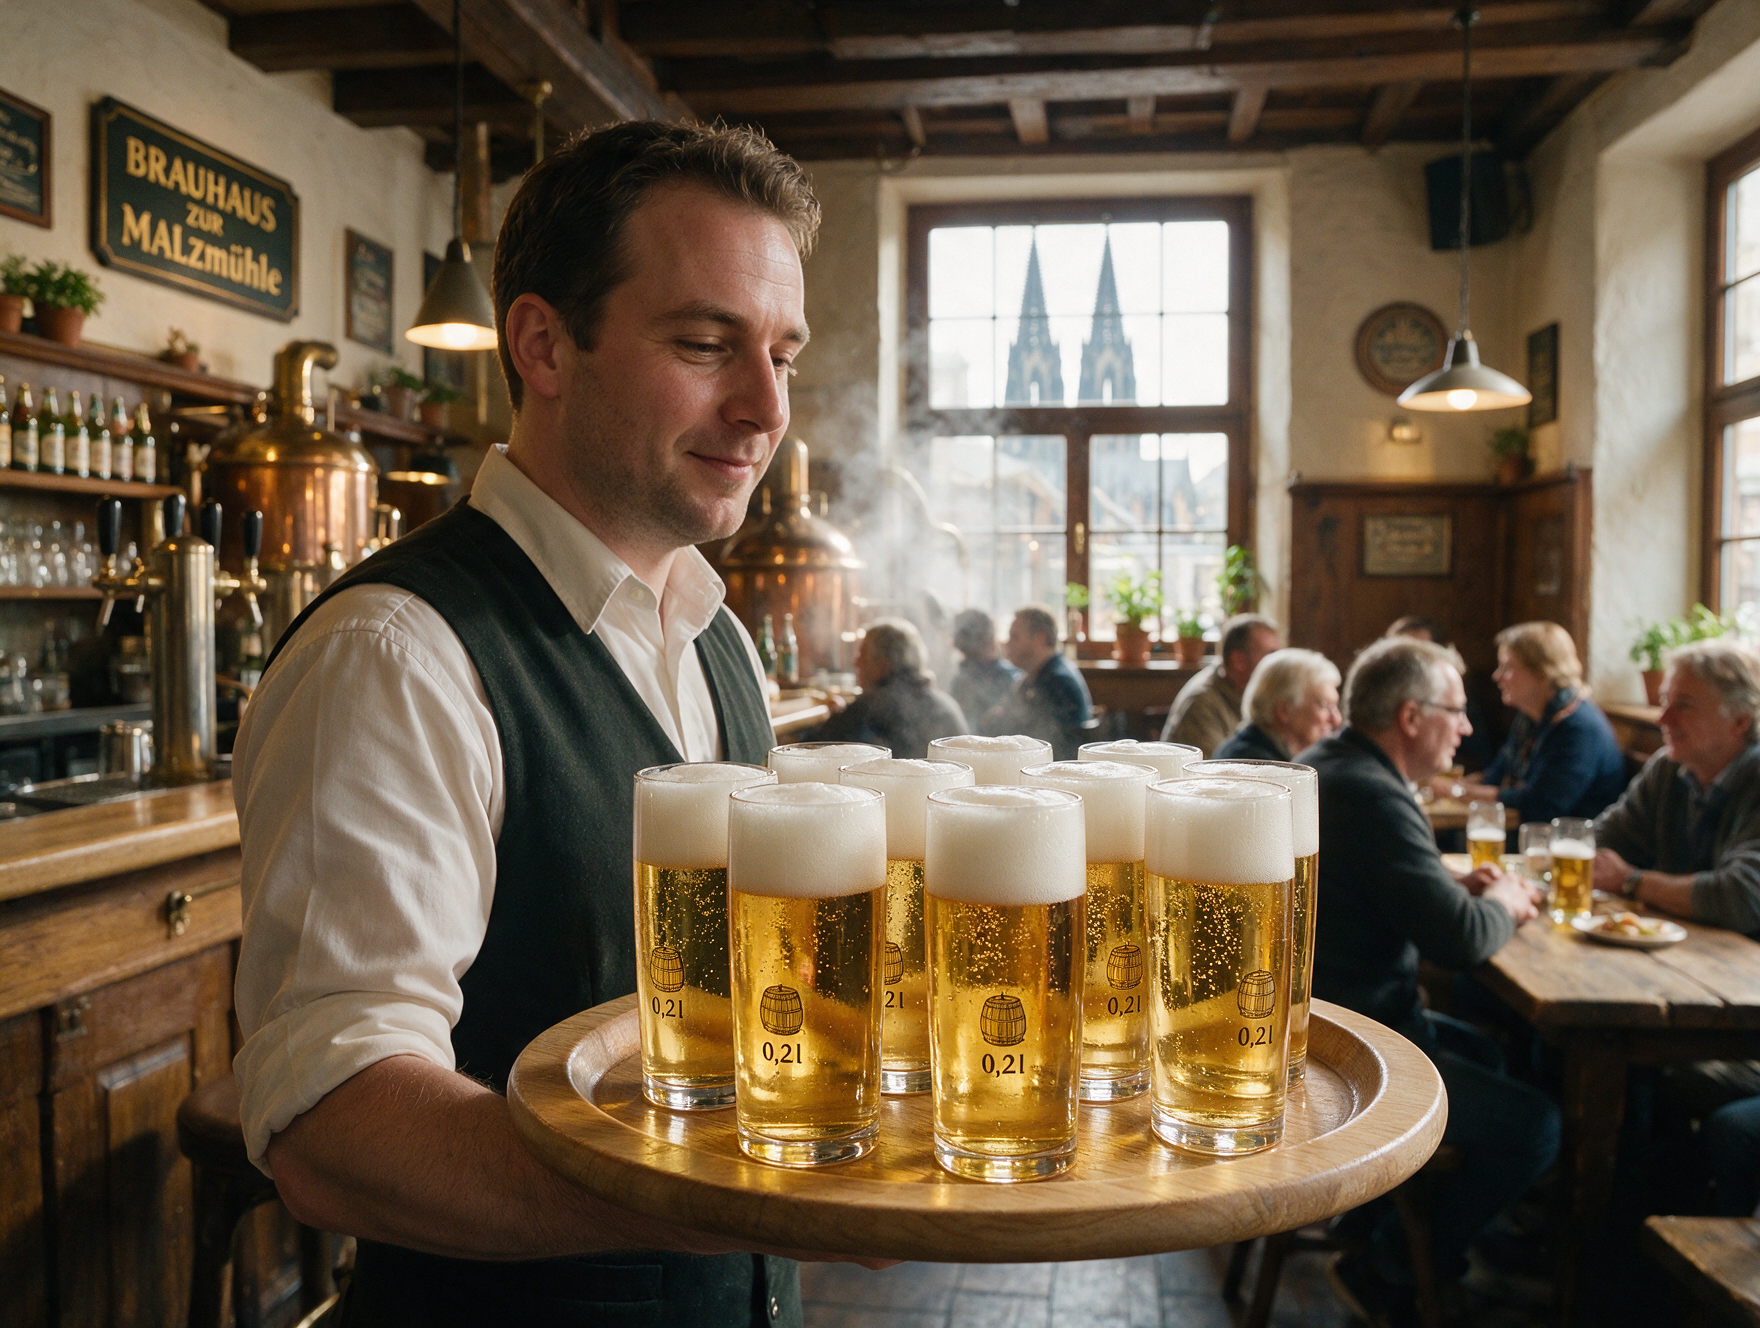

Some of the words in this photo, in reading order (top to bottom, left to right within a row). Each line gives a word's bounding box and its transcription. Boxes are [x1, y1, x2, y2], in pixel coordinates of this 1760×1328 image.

[126, 136, 277, 233] BRAUHAUS
[186, 202, 224, 237] ZUR
[121, 203, 282, 296] MALZmühle
[651, 996, 684, 1019] 0,2l
[1107, 996, 1142, 1017] 0,2l
[1237, 1026, 1274, 1049] 0,2l
[762, 1042, 803, 1066] 0,2l
[981, 1053, 1025, 1078] 0,2l
